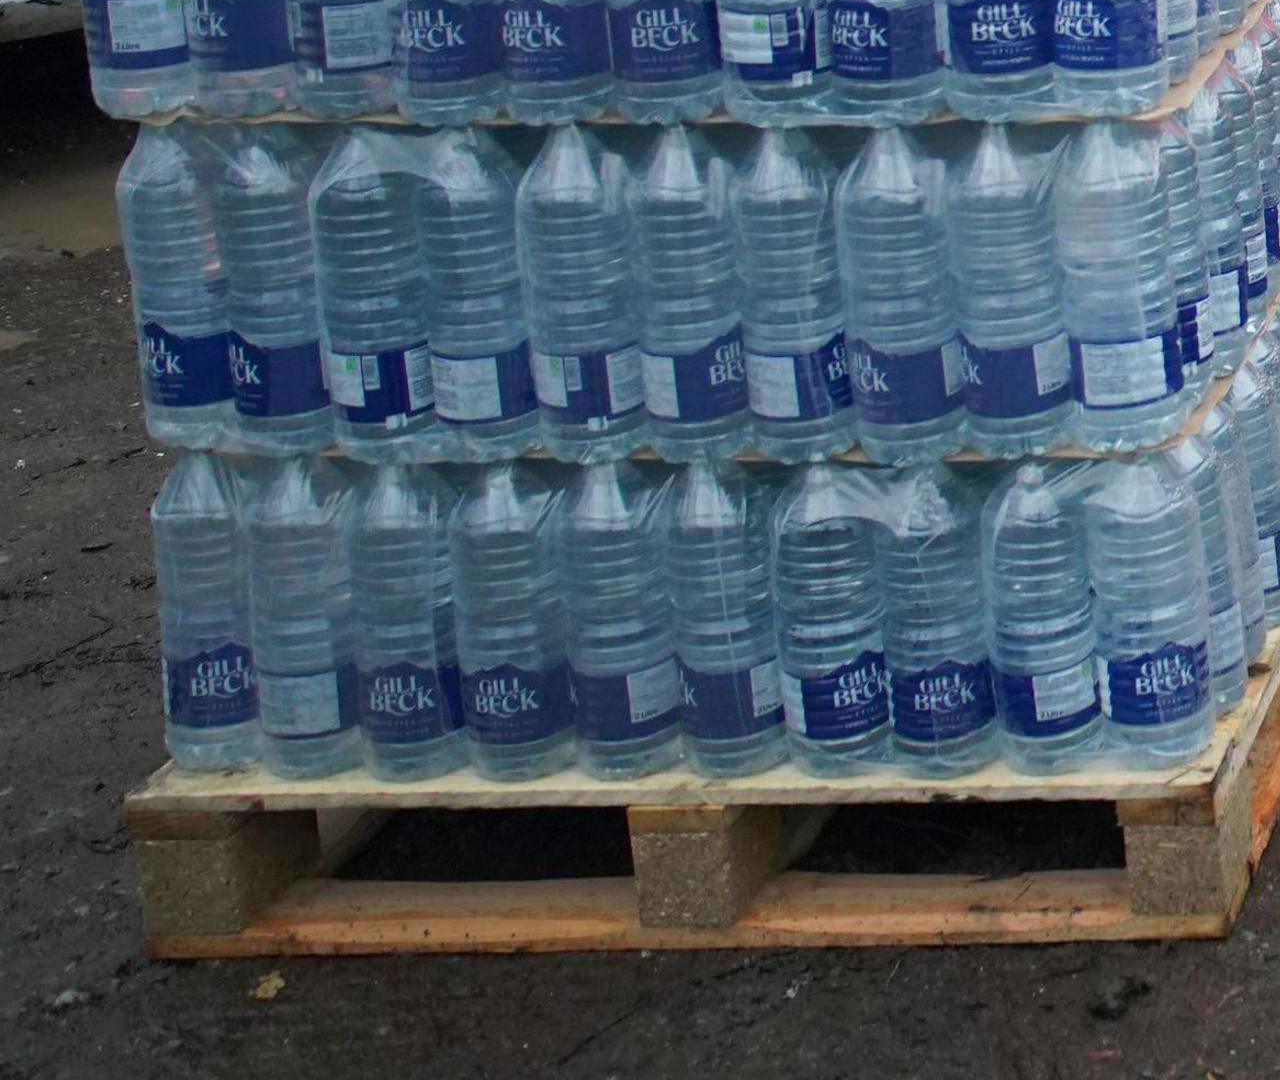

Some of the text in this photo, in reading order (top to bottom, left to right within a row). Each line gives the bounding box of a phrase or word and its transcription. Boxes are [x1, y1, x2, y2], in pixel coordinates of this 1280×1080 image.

[505, 9, 551, 28] GILL
[636, 7, 687, 28] GILL
[835, 10, 877, 28] GILL
[977, 2, 1027, 21] GILL
[1057, 0, 1100, 17] GILL
[400, 24, 465, 52] BECK
[502, 26, 565, 52] BECK
[631, 21, 700, 52] BECK
[832, 23, 888, 51] BECK
[971, 16, 1036, 43] BECK
[1053, 14, 1111, 40] BECK
[197, 656, 249, 677] GILL
[838, 662, 878, 689] GILL
[1141, 654, 1187, 677] GILL
[375, 676, 424, 694] GILL
[479, 677, 526, 696] GILL
[919, 673, 966, 694] GILL
[1135, 665, 1194, 696] BECK
[370, 688, 435, 716] BECK
[475, 687, 539, 718] BECK
[914, 682, 975, 713] BECK
